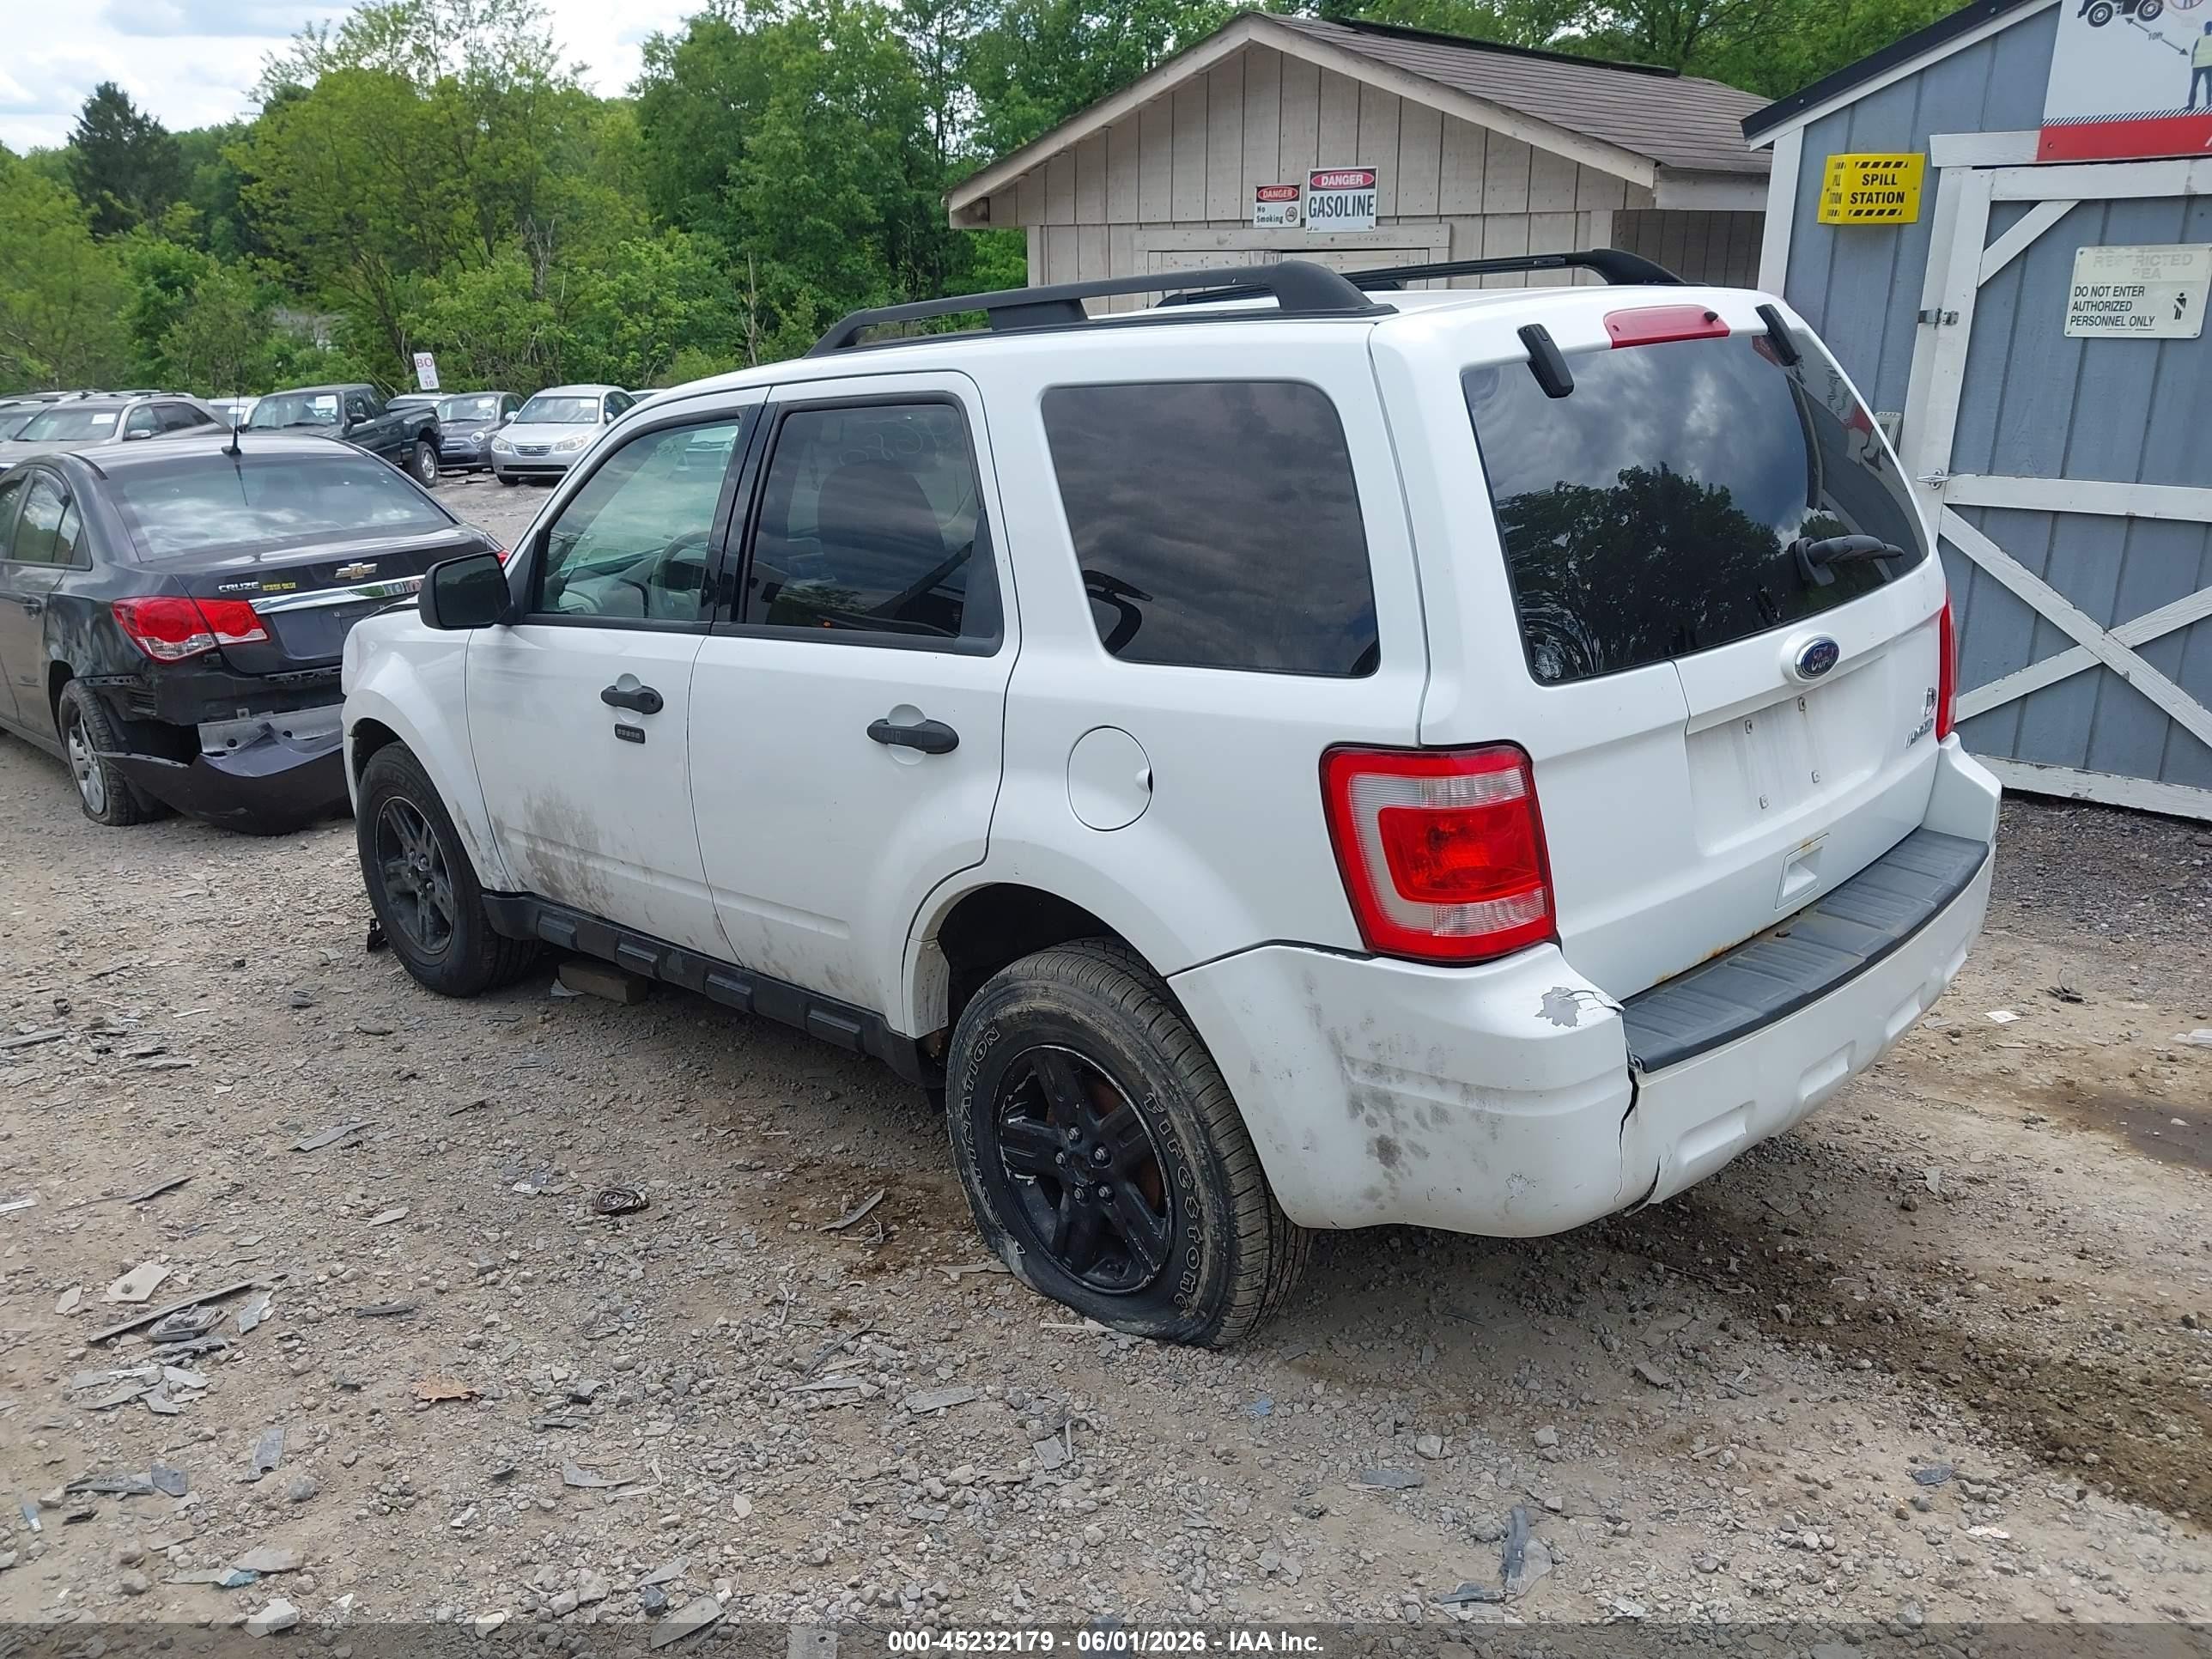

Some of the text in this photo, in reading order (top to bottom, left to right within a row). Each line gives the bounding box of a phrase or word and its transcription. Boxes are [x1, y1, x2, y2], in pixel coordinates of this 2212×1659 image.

[1321, 174, 1364, 185] DANGER
[1862, 173, 1898, 186] SPILL
[1262, 190, 1293, 198] DANGER
[1850, 191, 1905, 204] STATION
[1308, 195, 1374, 218] GASOLINE
[1256, 215, 1284, 224] Smoking
[2075, 285, 2145, 297] DO NOT ENTER
[2072, 301, 2132, 312] AUTHORIZED
[2069, 315, 2155, 326] PERSONNEL ONLY
[218, 581, 260, 592] CRUZE
